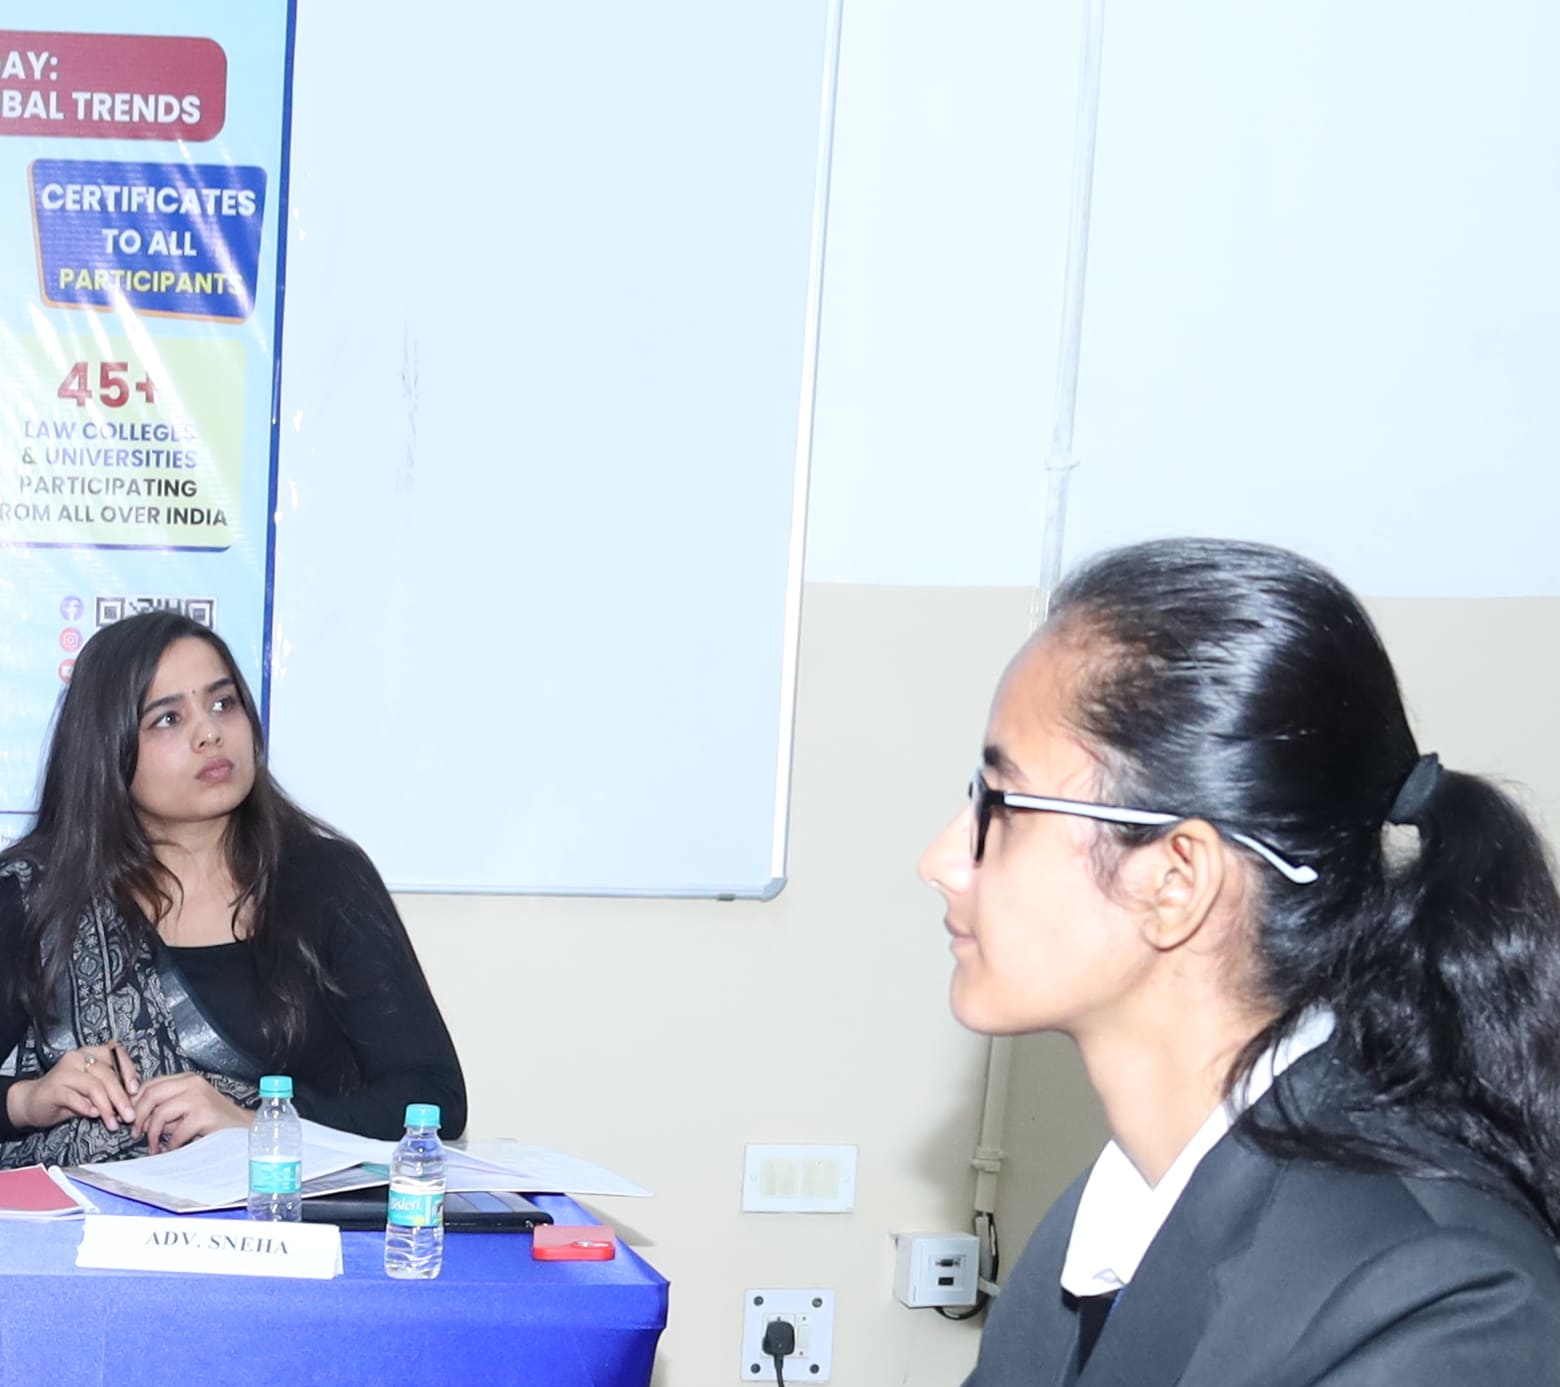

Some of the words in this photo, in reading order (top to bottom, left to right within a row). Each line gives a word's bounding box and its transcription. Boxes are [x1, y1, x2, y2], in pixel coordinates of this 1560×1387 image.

[71, 91, 201, 125] TRENDS
[41, 183, 257, 217] CERTIFICATES
[101, 228, 142, 255] TO
[147, 230, 198, 257] ALL
[59, 267, 245, 296] PARTICIPANTS
[57, 361, 159, 409] 45+
[24, 420, 77, 440] LAW
[22, 447, 36, 465] &
[46, 447, 198, 470] UNIVERSITIES
[19, 476, 198, 498] PARTICIPATING
[57, 504, 94, 523] ALL
[100, 506, 160, 525] OVER
[166, 507, 228, 527] INDIA
[144, 1230, 201, 1249] ADV.
[208, 1233, 289, 1255] SNEHA
